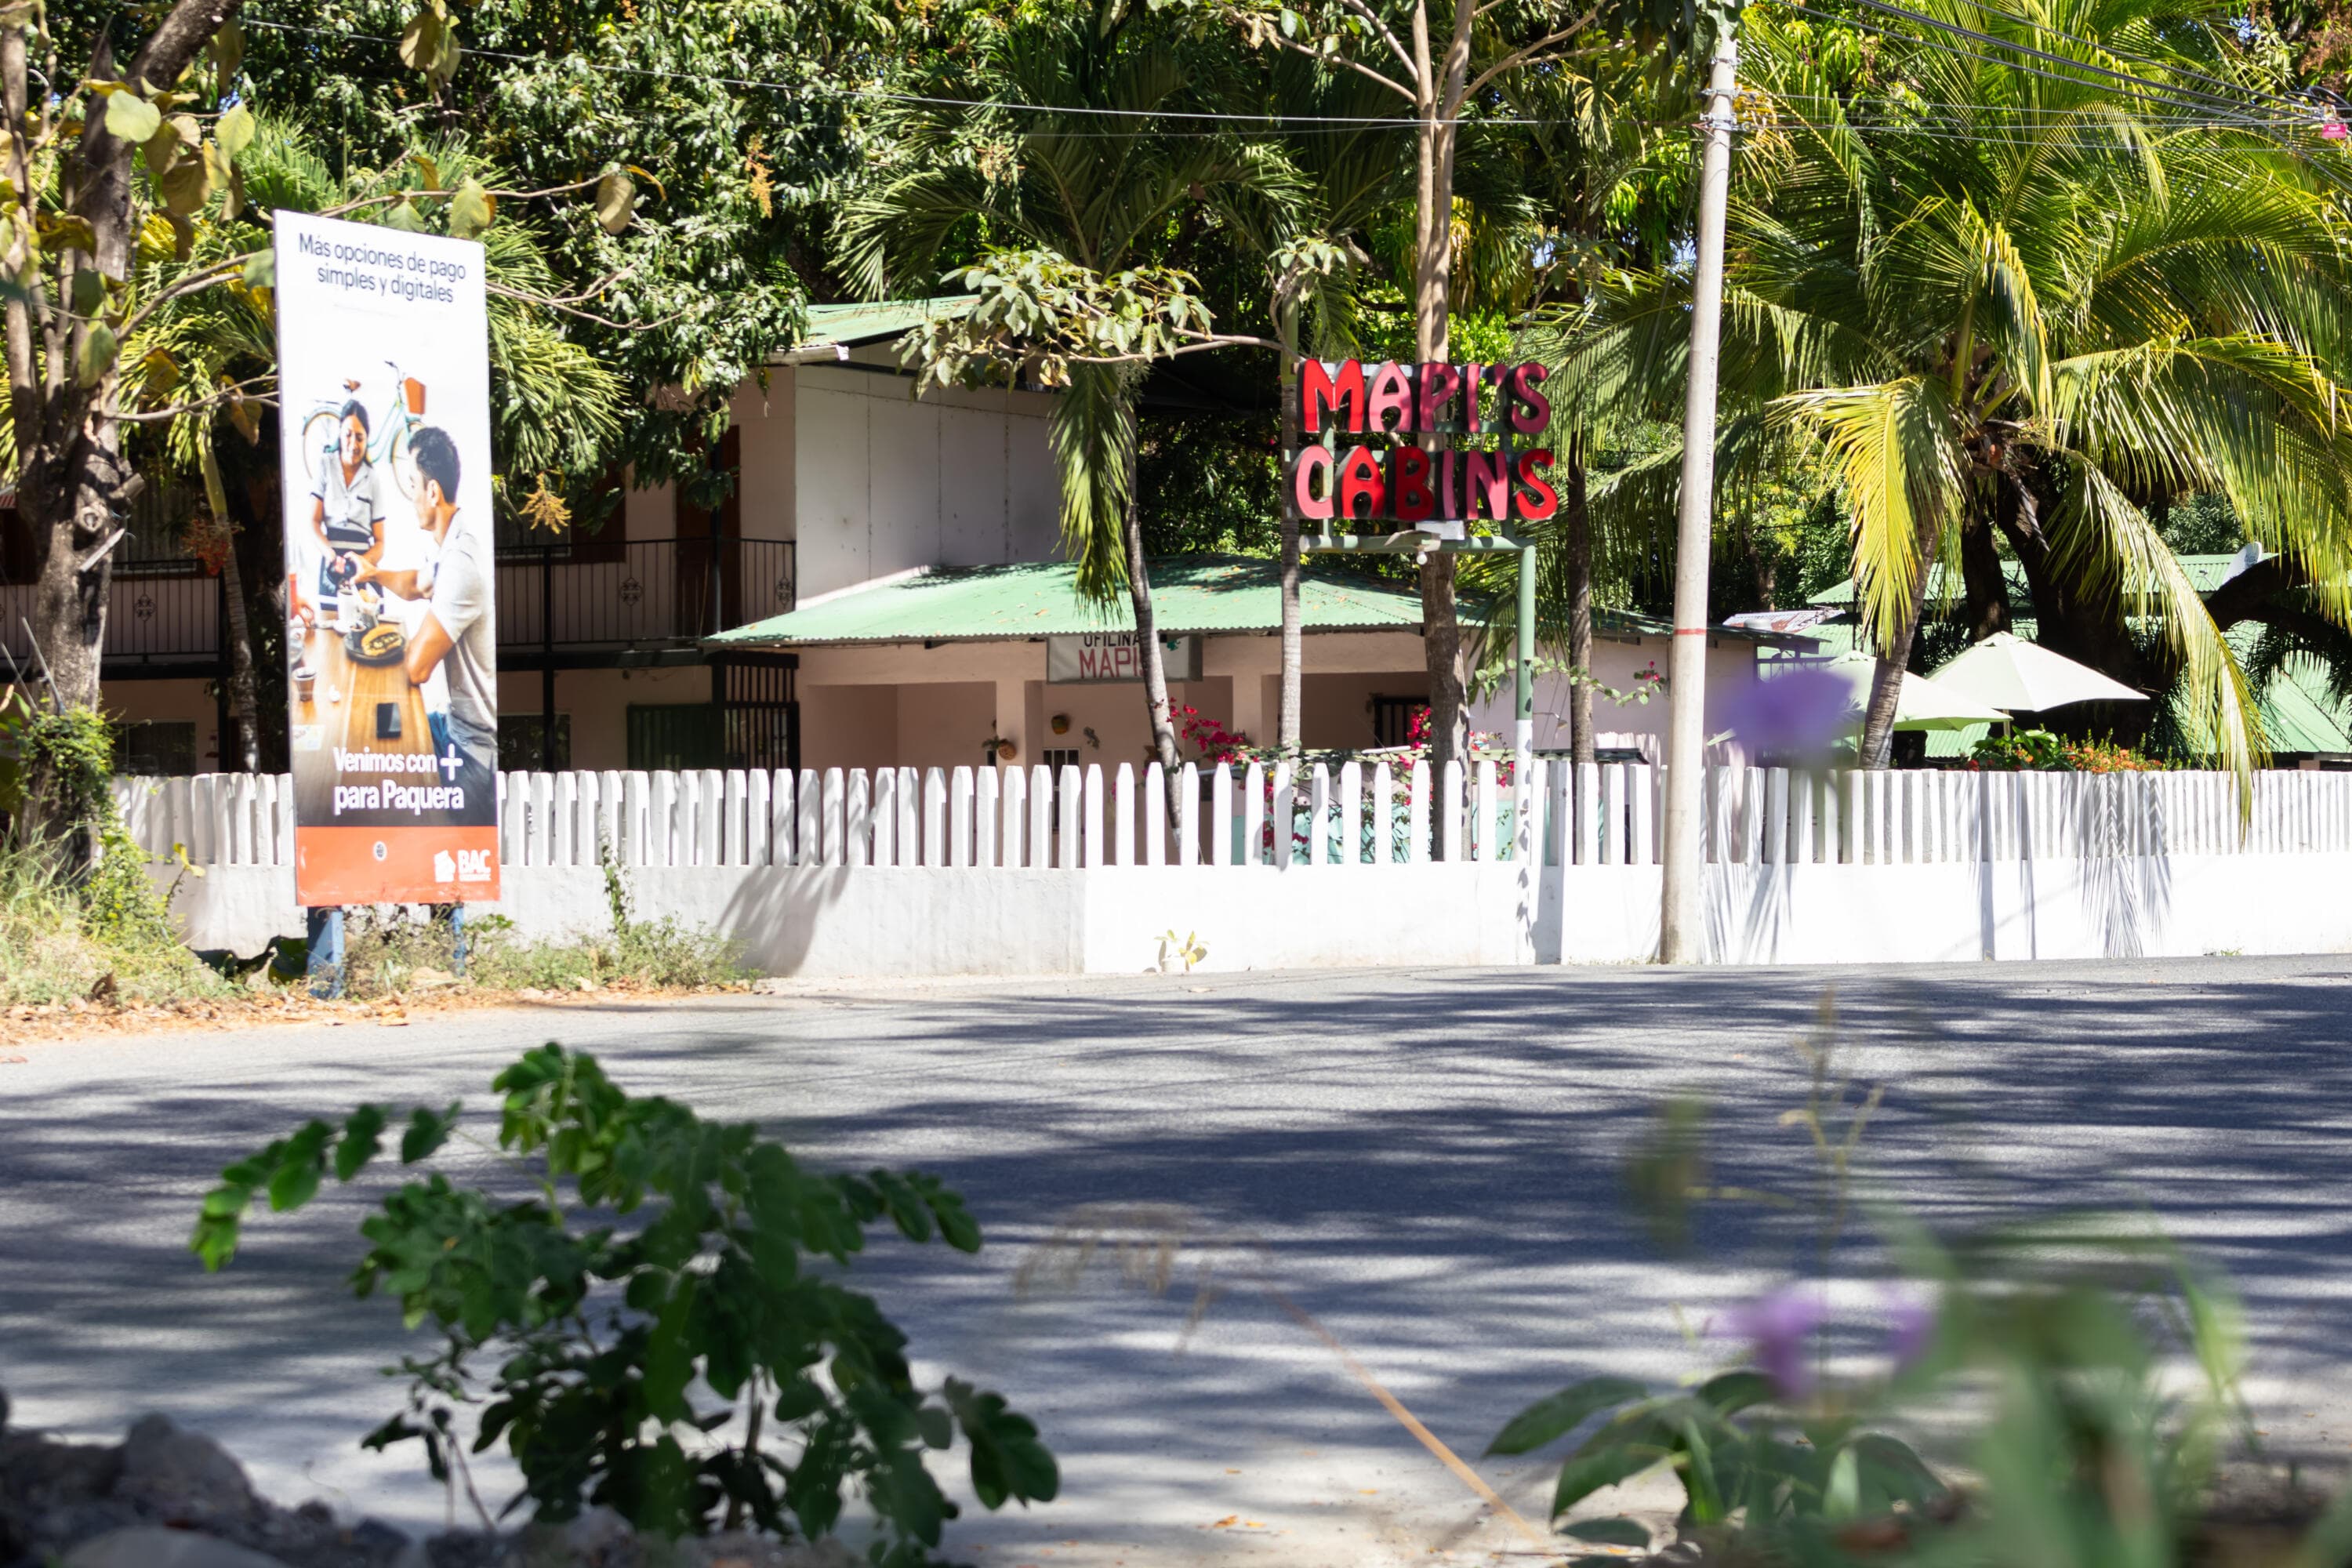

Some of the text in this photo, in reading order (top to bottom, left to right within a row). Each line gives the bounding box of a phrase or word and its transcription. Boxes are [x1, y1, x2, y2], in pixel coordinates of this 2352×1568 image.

[299, 233, 466, 282] Más opciones de pago
[318, 263, 453, 303] simples y digitales
[1298, 358, 1551, 433] MAPI'S
[1292, 445, 1558, 521] CABINS
[1079, 648, 1144, 679] MAPI
[333, 746, 405, 772] Venimos
[405, 755, 437, 772] con
[334, 779, 464, 815] para Paquera
[457, 850, 491, 874] BAC
